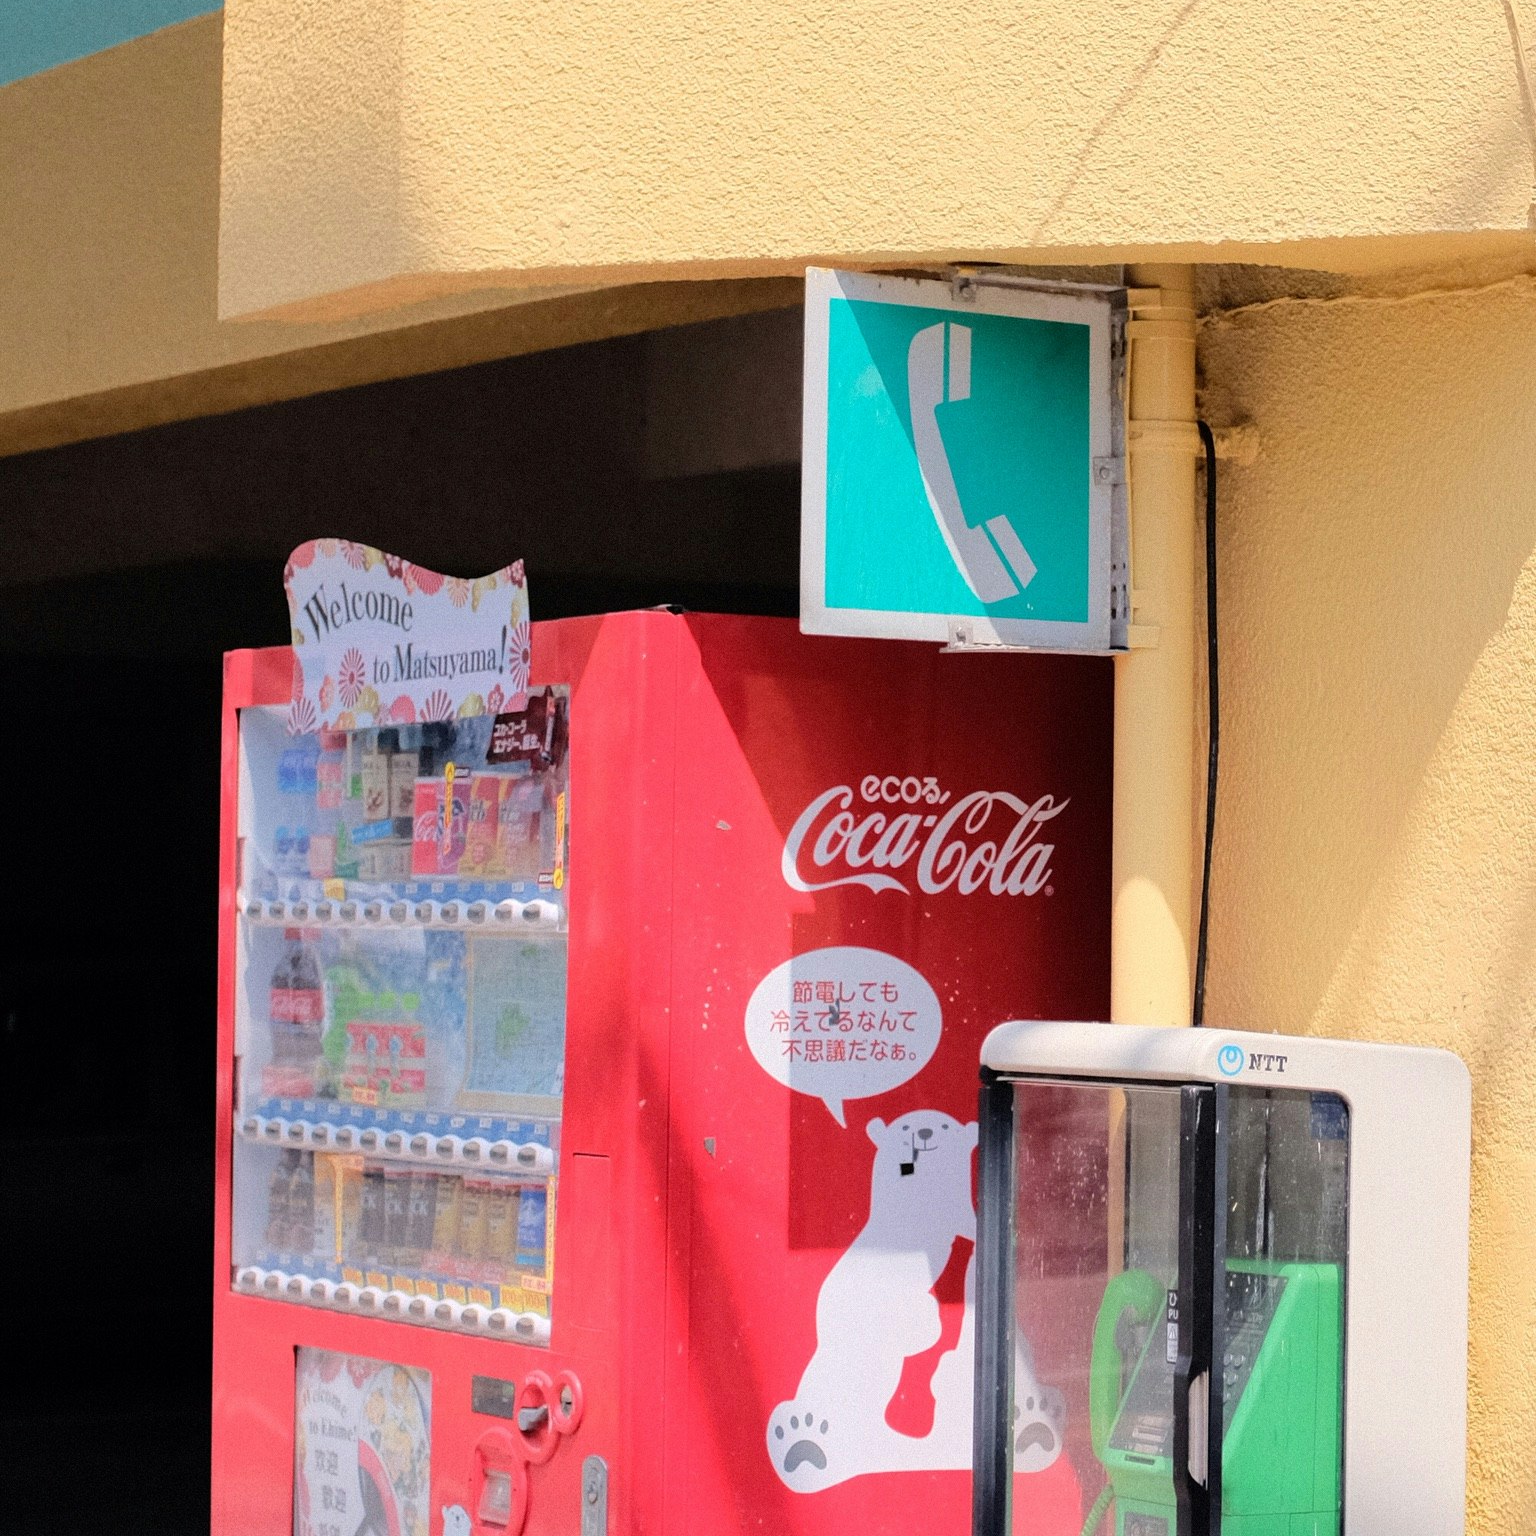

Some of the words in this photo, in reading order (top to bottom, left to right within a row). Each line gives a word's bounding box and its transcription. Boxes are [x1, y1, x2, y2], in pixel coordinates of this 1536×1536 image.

[303, 581, 414, 644] Welcome
[372, 654, 390, 685] to
[393, 624, 508, 683] Matsuyama!
[781, 784, 1072, 897] Coca-Cola
[792, 980, 899, 1004] 節電しても
[769, 1009, 918, 1033] 冷えてるなんて
[781, 1039, 918, 1063] 不思議だなぁ。
[1248, 1053, 1288, 1073] NTT
